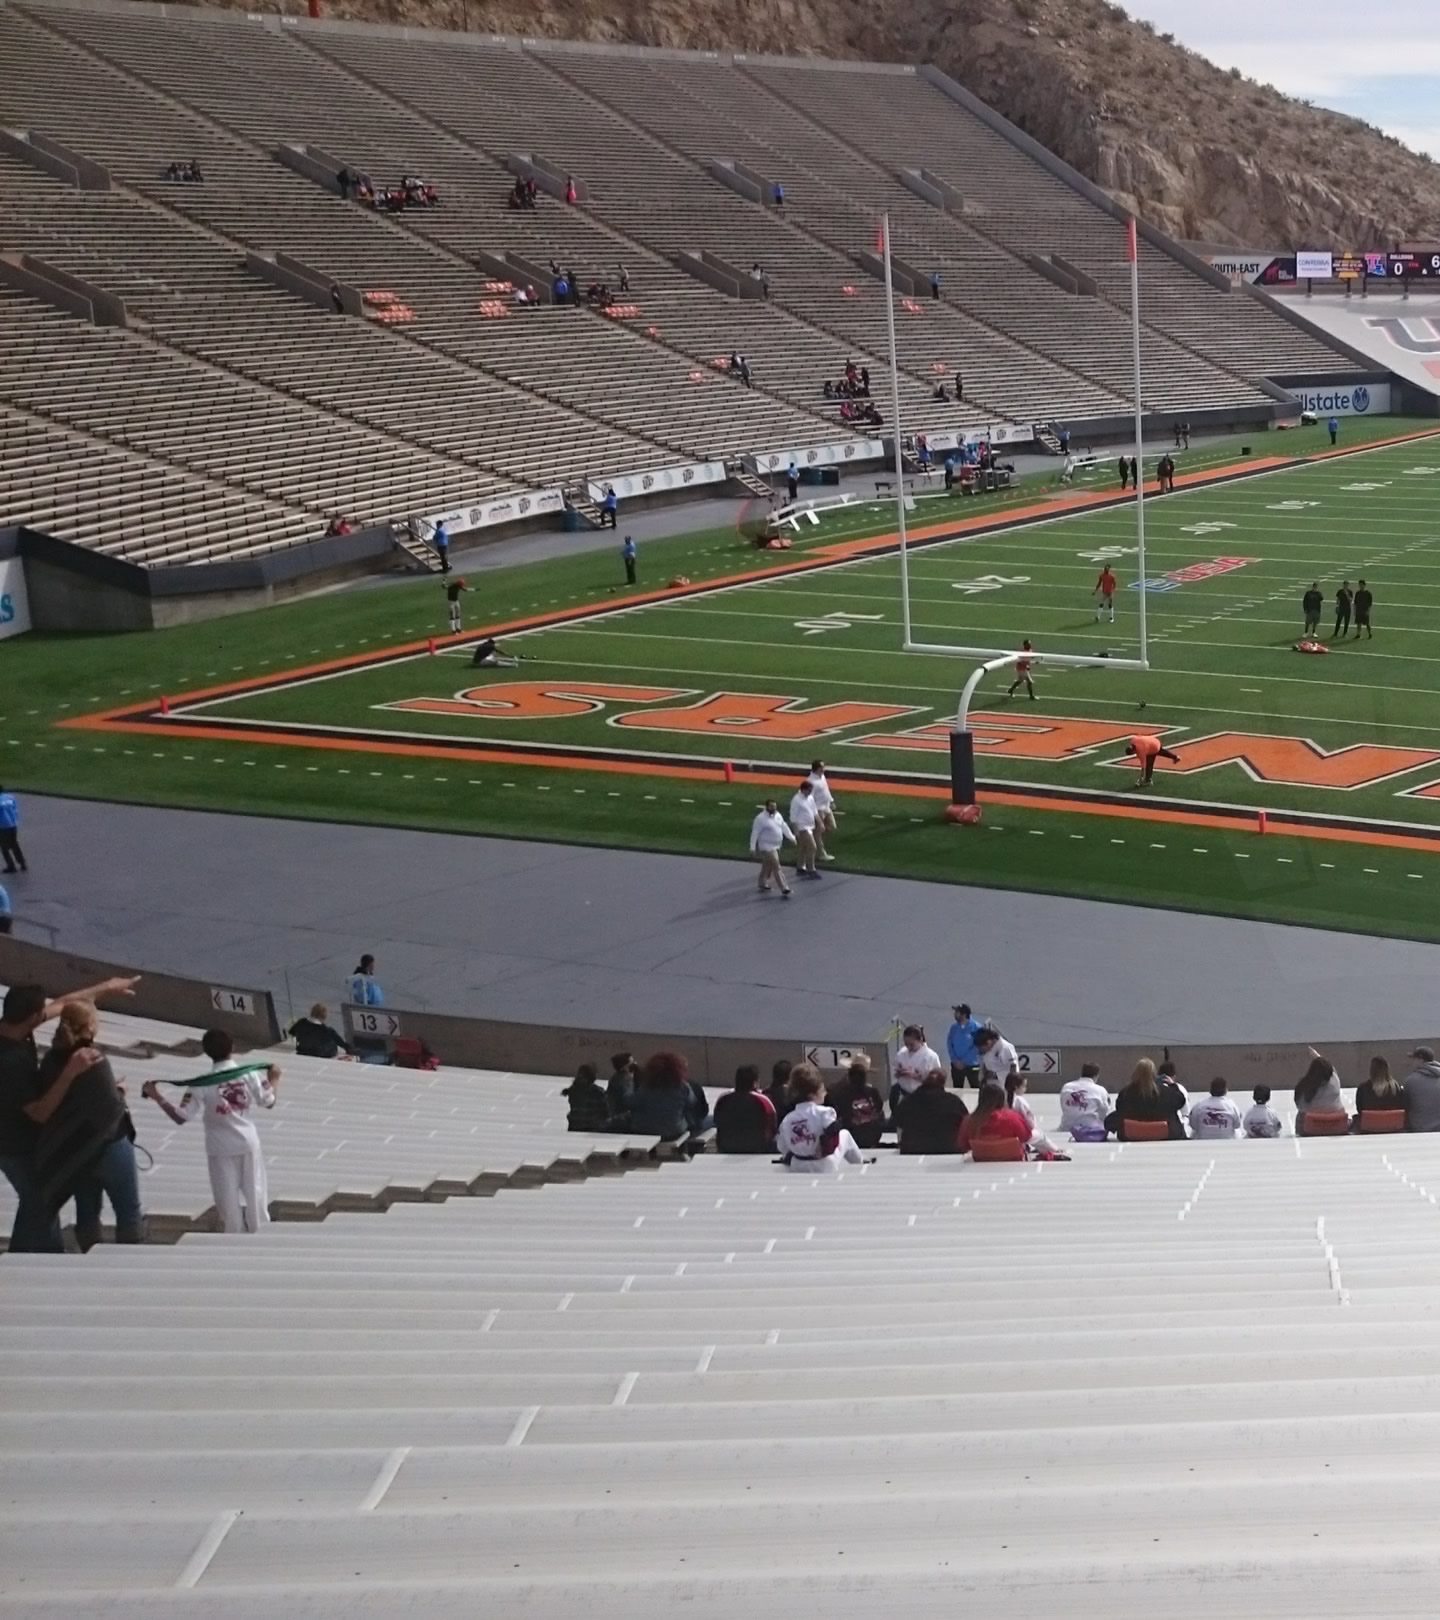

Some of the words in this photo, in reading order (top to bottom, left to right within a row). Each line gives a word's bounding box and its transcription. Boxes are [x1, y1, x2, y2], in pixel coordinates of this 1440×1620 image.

[1393, 262, 1403, 276] 0
[952, 574, 1031, 592] 20
[794, 611, 885, 631] 10
[230, 994, 246, 1012] 14
[359, 1013, 378, 1032] 13
